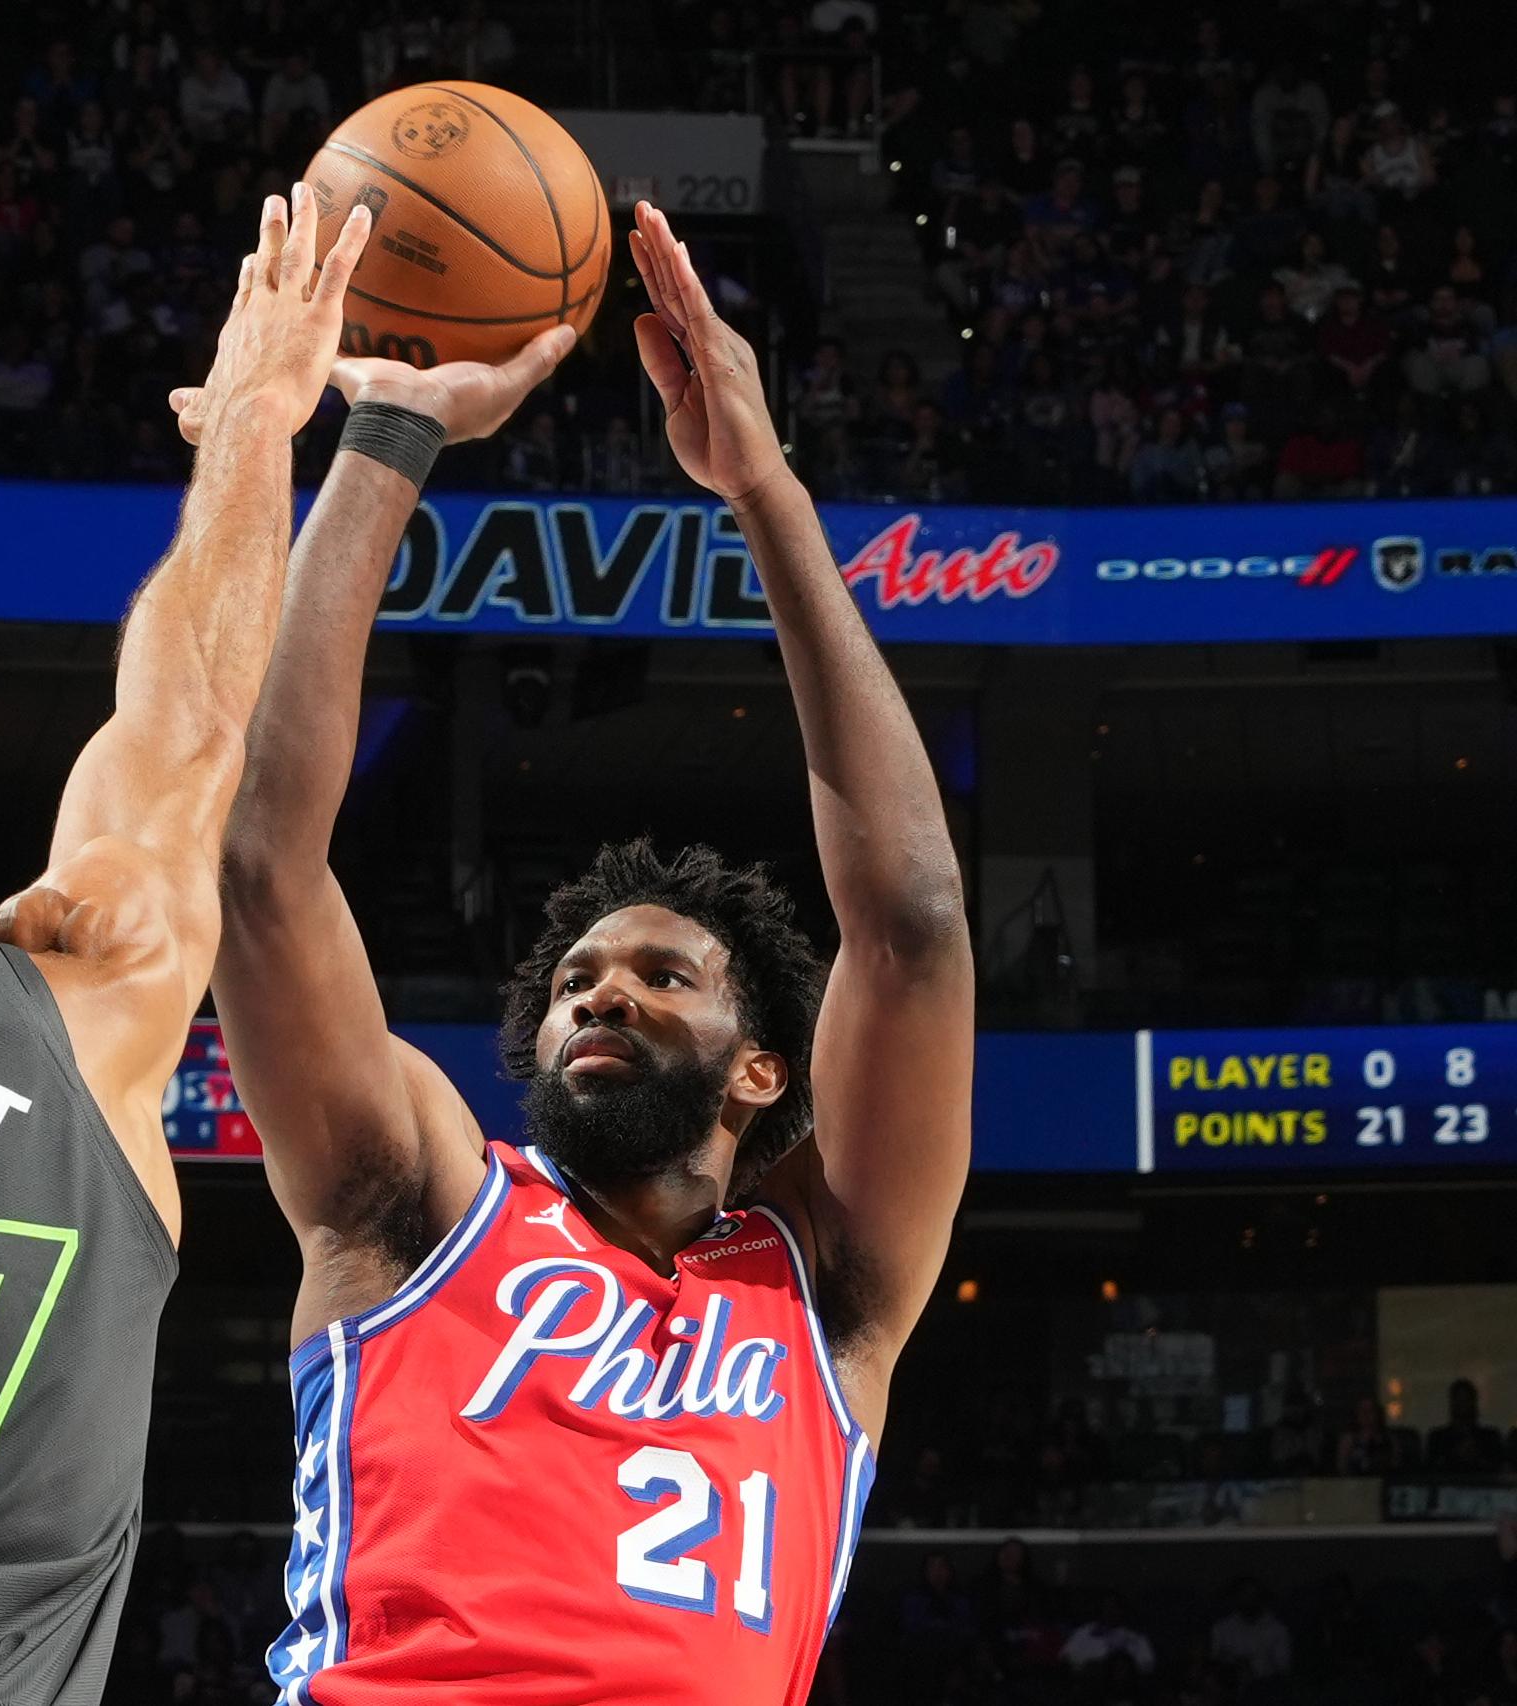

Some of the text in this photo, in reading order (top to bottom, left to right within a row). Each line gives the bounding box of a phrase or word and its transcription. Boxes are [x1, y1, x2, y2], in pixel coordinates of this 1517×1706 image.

[677, 174, 749, 208] 220
[841, 513, 1060, 610] Auto
[1096, 555, 1321, 580] DODGE
[1169, 1047, 1476, 1089] PLAYER 0 8
[1175, 1103, 1489, 1146] POINTS 21 23
[683, 1236, 780, 1264] crypto.com
[459, 1257, 788, 1423] Phila
[616, 1446, 777, 1636] 21
